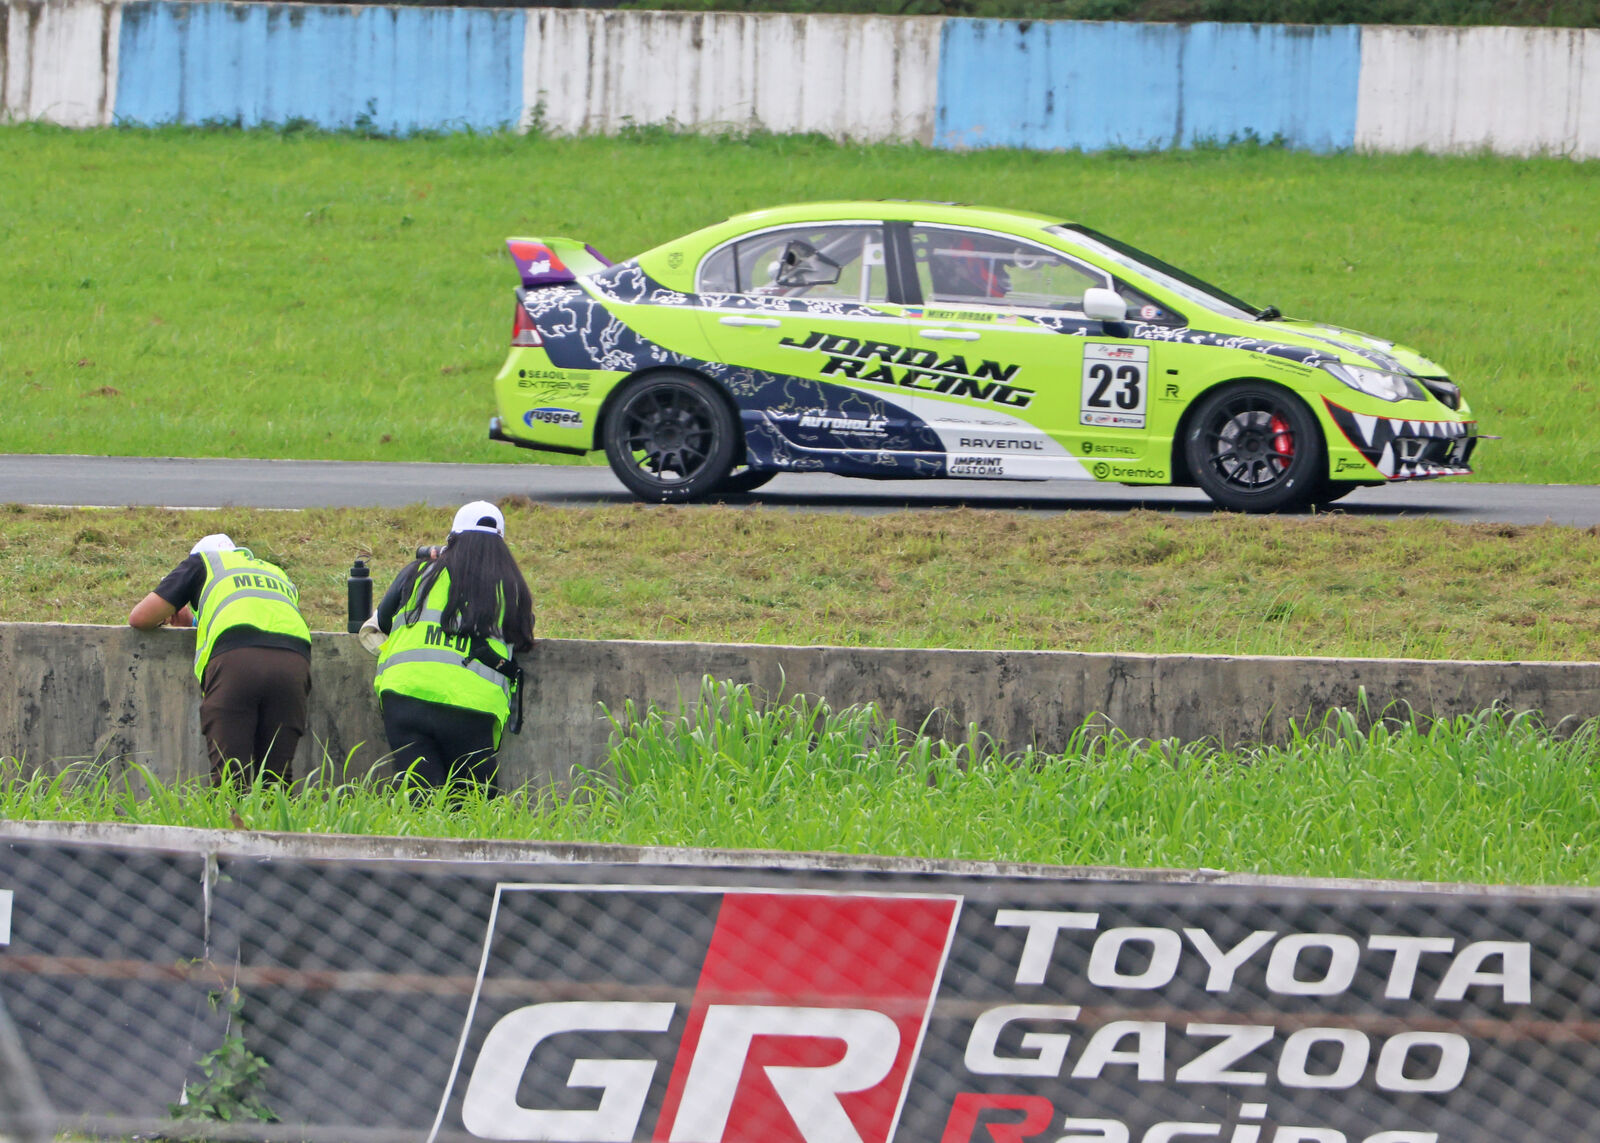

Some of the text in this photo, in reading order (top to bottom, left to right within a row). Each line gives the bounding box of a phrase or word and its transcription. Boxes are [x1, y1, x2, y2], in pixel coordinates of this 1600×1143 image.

[957, 311, 993, 321] JORDAN
[778, 331, 1021, 383] JORDAN
[528, 370, 566, 379] SEAOIL
[518, 379, 591, 391] EXTREME
[820, 356, 1037, 409] RACING
[1087, 363, 1140, 409] 23
[960, 438, 1043, 450] RAVENOL
[1095, 445, 1137, 454] BETHEL
[954, 457, 1002, 466] IMPRINT
[949, 466, 1004, 475] CUSTOMS
[1112, 466, 1165, 479] brembo
[994, 909, 1531, 1004] TOYOTA
[963, 1004, 1471, 1093] GAZOO
[462, 1001, 900, 1143] GR
